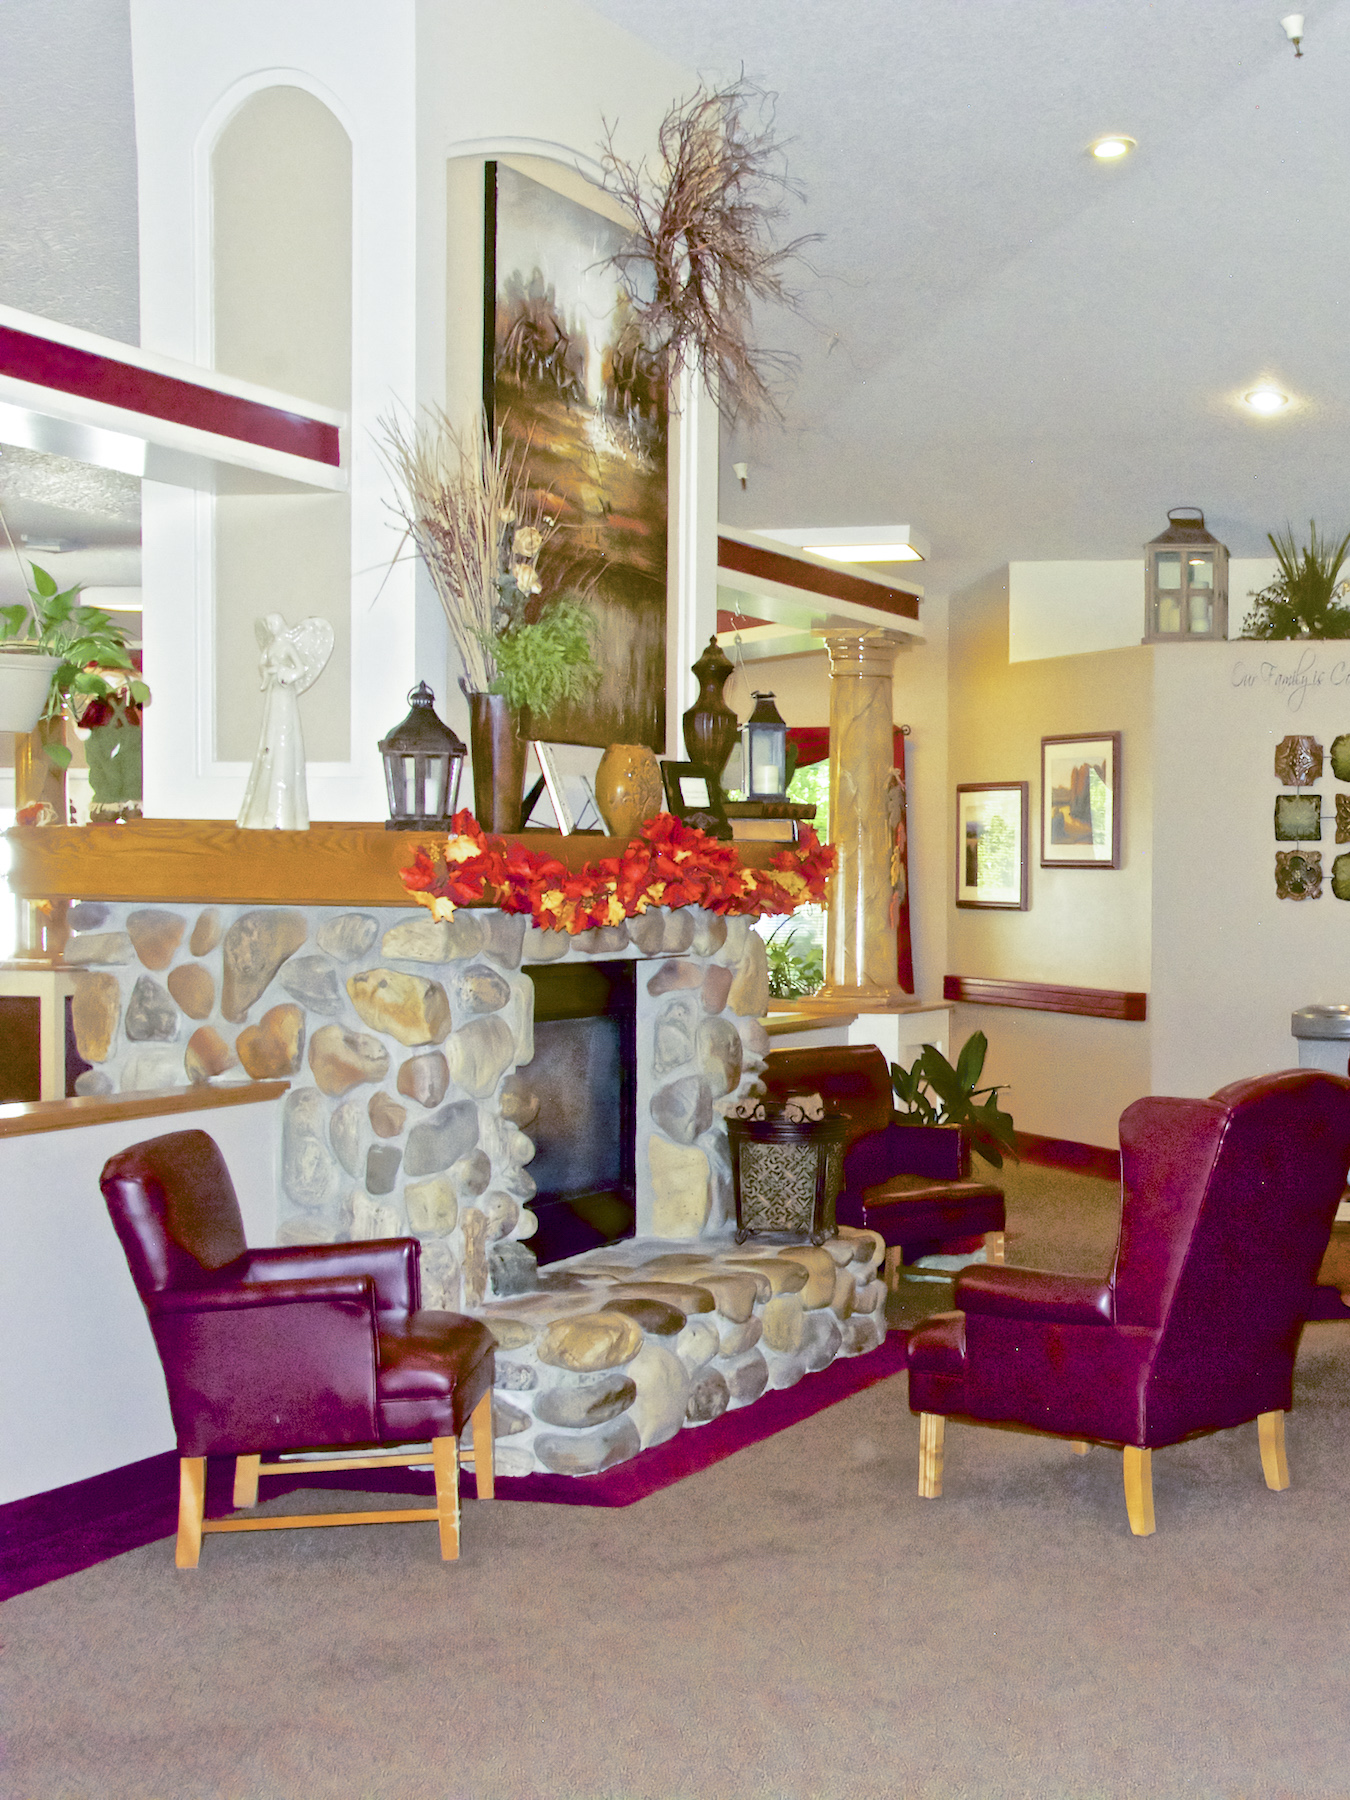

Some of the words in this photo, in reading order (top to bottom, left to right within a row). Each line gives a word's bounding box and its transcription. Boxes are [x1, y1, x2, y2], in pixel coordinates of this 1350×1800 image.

[1231, 661, 1255, 687] Our
[1261, 648, 1316, 712] Family
[1312, 670, 1324, 686] is
